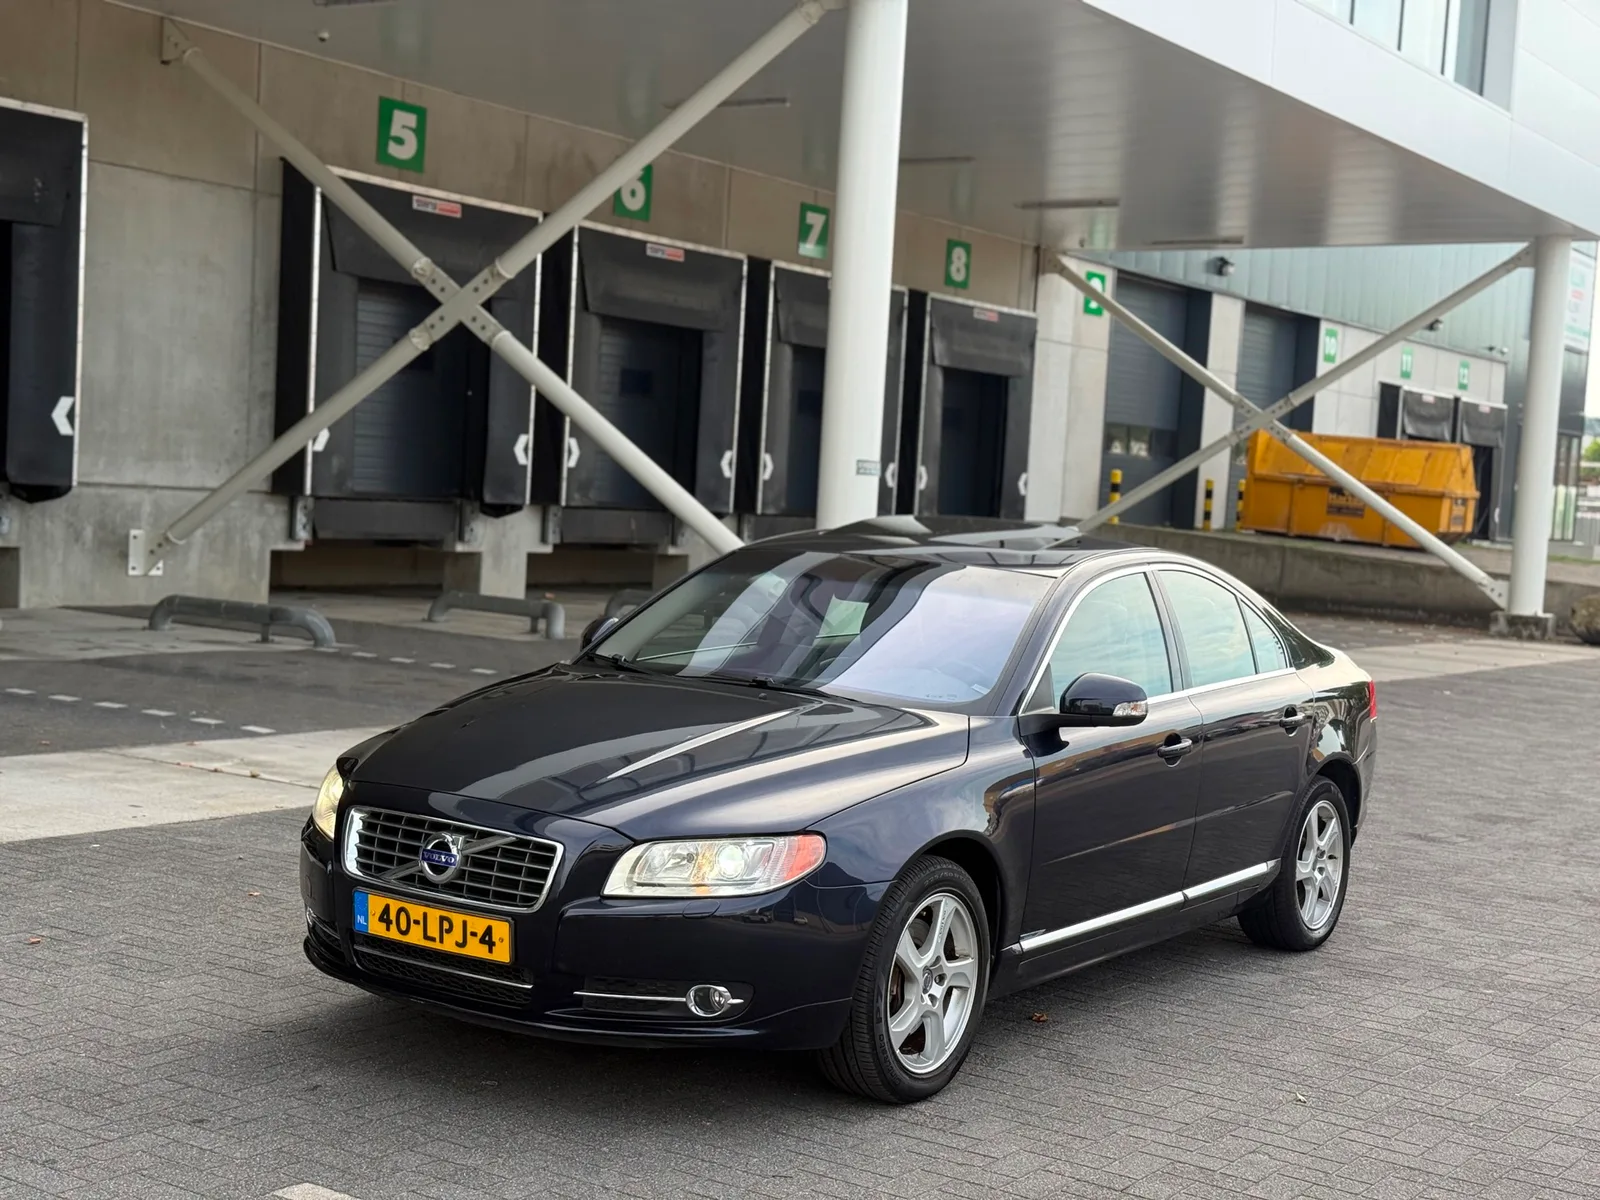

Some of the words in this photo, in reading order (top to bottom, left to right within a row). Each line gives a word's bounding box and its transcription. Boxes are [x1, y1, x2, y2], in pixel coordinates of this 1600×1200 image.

[387, 109, 418, 160] 5
[620, 170, 646, 211] 6
[805, 211, 827, 249] 7
[950, 246, 967, 283] 8
[1325, 336, 1337, 357] 10
[1402, 353, 1412, 372] 11
[422, 851, 455, 866] VOLVO
[357, 914, 367, 925] NL
[378, 903, 496, 954] 40-LPJ-4
